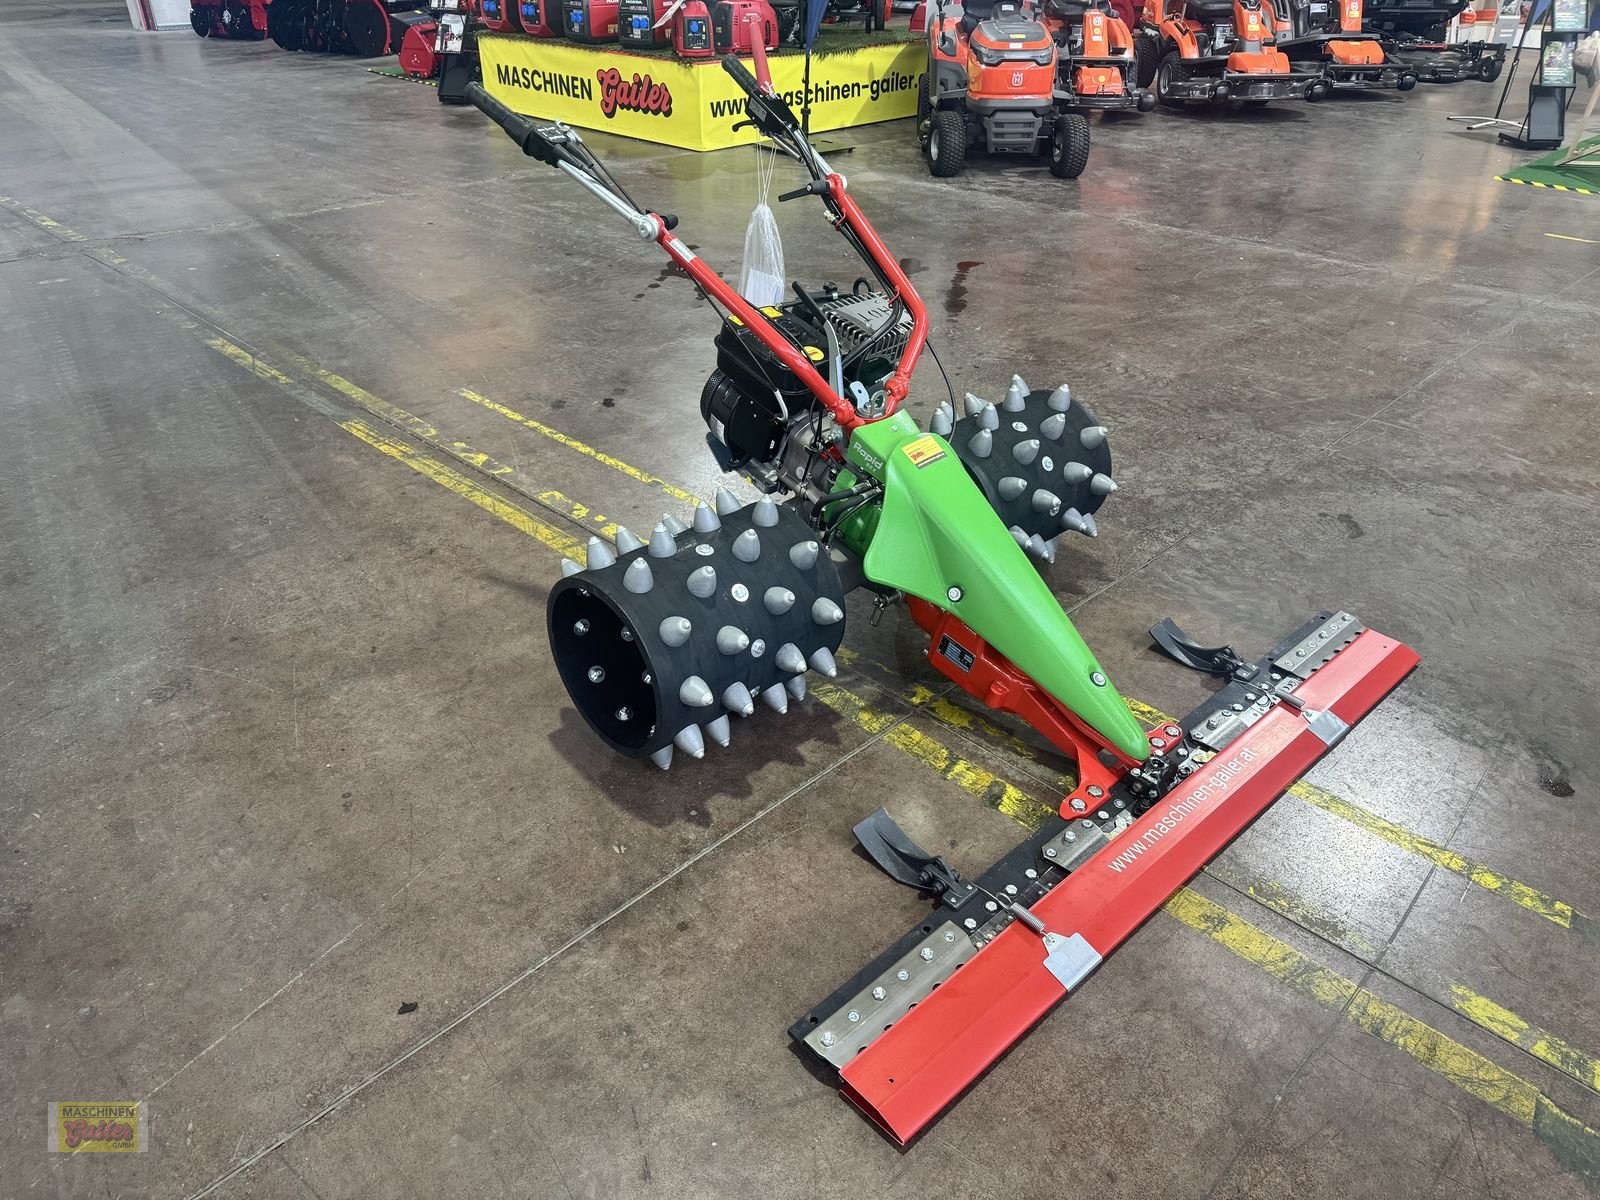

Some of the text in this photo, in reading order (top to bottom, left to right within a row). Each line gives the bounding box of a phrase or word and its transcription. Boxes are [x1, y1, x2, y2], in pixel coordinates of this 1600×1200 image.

[496, 64, 672, 118] MASCHINEN Gailer
[710, 72, 924, 118] wwaschinen-gailer.
[853, 442, 883, 469] Rapid
[1108, 748, 1258, 873] www.maschinen-gailer.at
